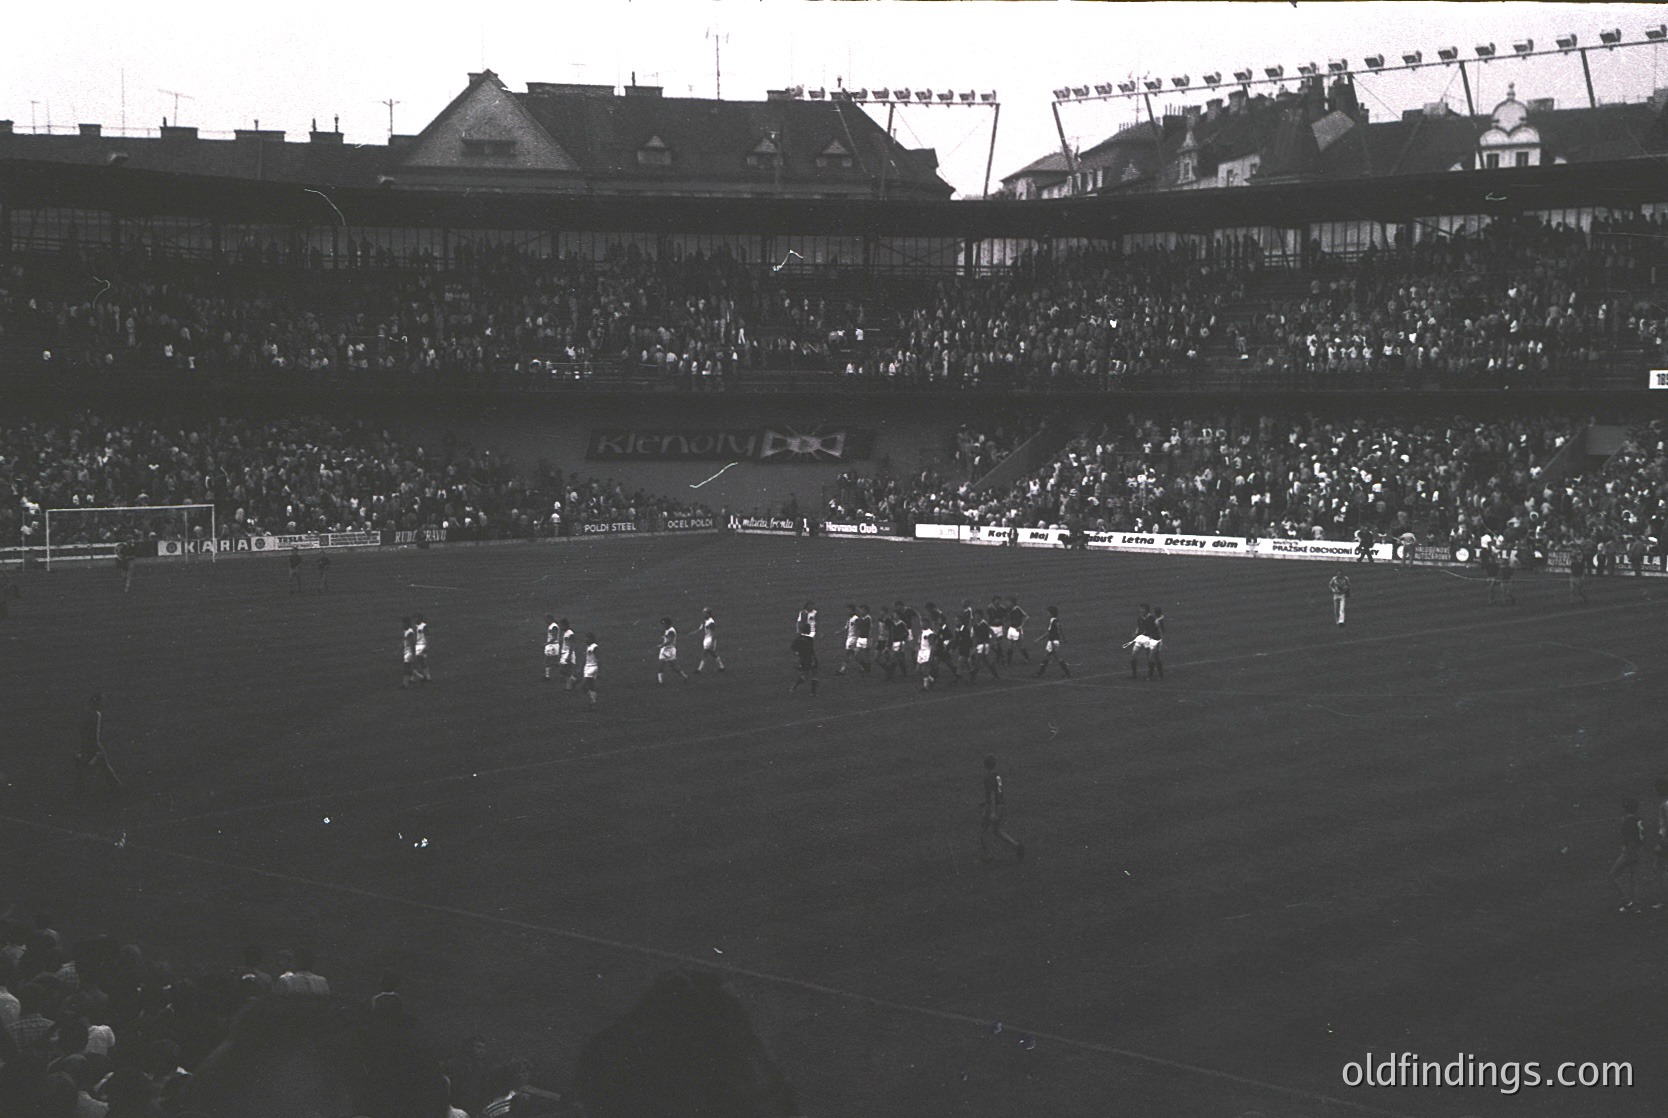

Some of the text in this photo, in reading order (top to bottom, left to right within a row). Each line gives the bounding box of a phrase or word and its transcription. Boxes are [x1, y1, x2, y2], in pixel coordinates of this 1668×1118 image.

[584, 522, 636, 532] POLDI STEEL
[667, 518, 713, 528] OCEL POLDI
[859, 522, 878, 534] Club
[184, 539, 249, 553] KARA
[1309, 546, 1353, 555] OBCHODNÍ
